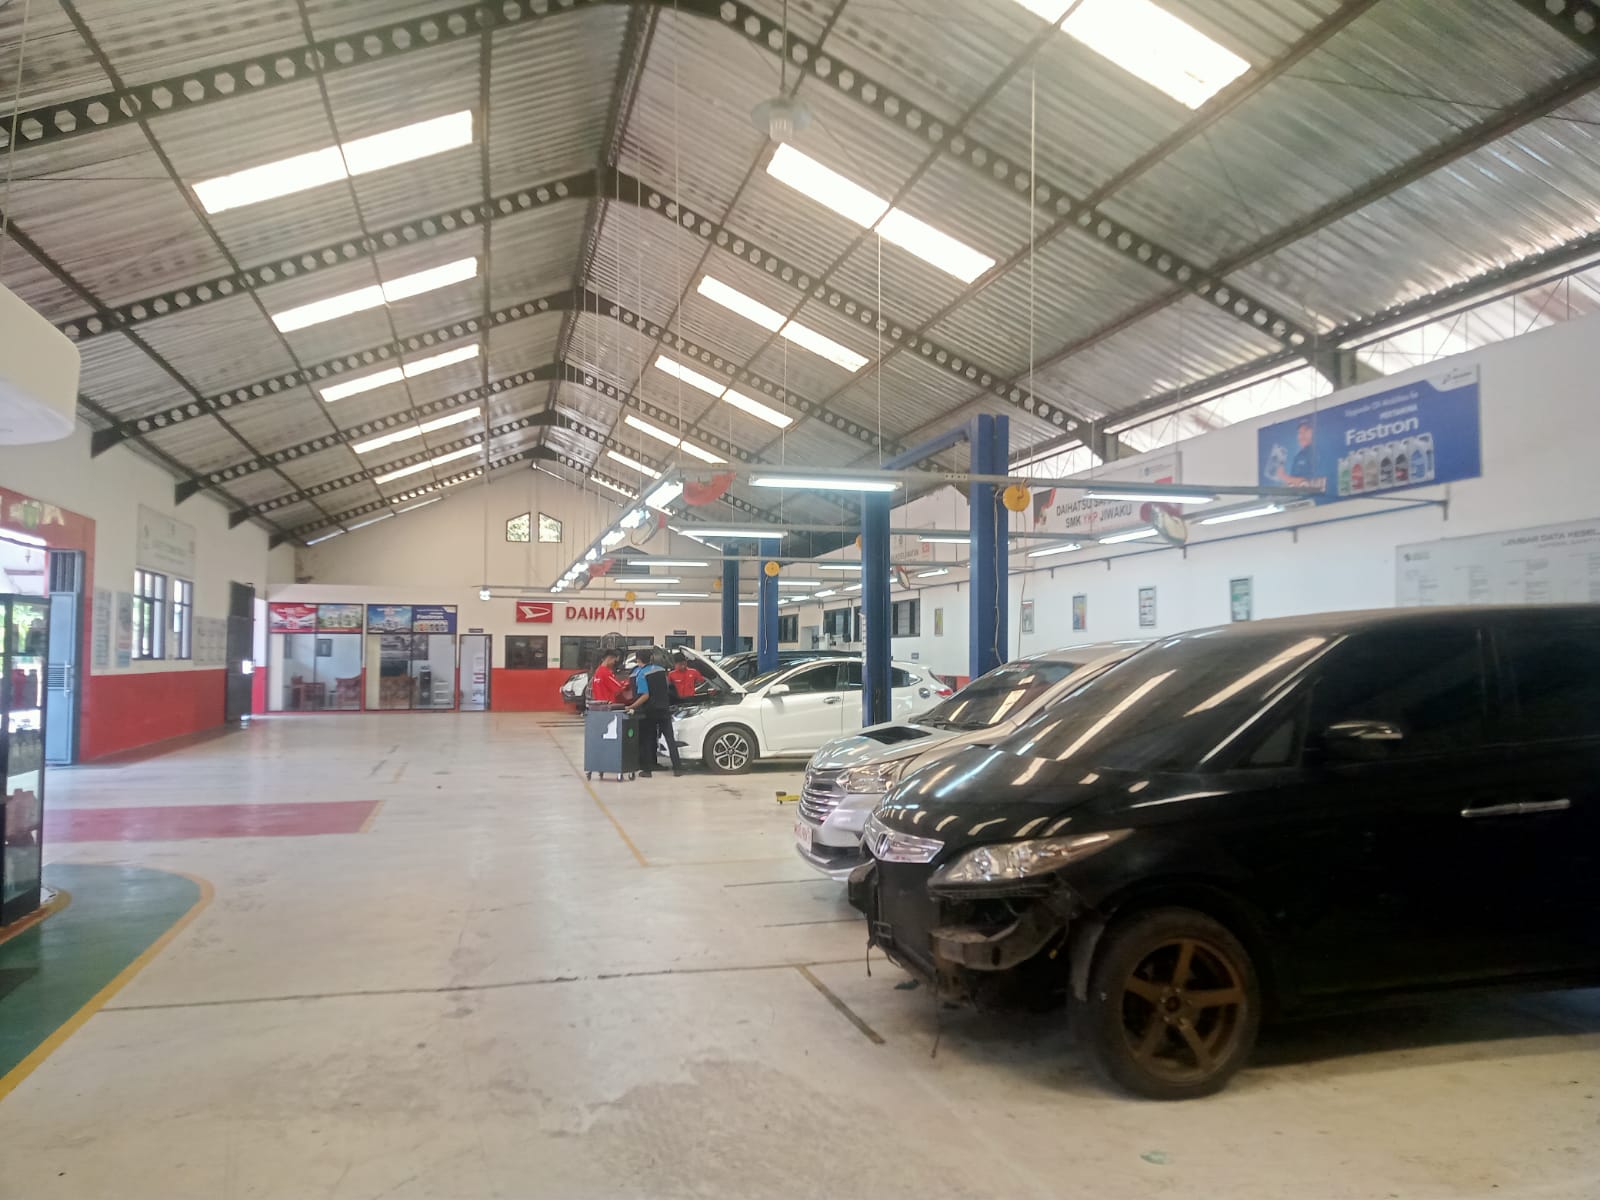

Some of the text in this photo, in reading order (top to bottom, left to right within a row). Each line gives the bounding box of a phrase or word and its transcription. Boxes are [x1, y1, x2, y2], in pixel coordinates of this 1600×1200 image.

[1345, 417, 1418, 445] Fastron
[1056, 499, 1091, 516] DAIHATSU
[1065, 515, 1081, 528] SMK
[565, 606, 645, 621] DAIHATSU
